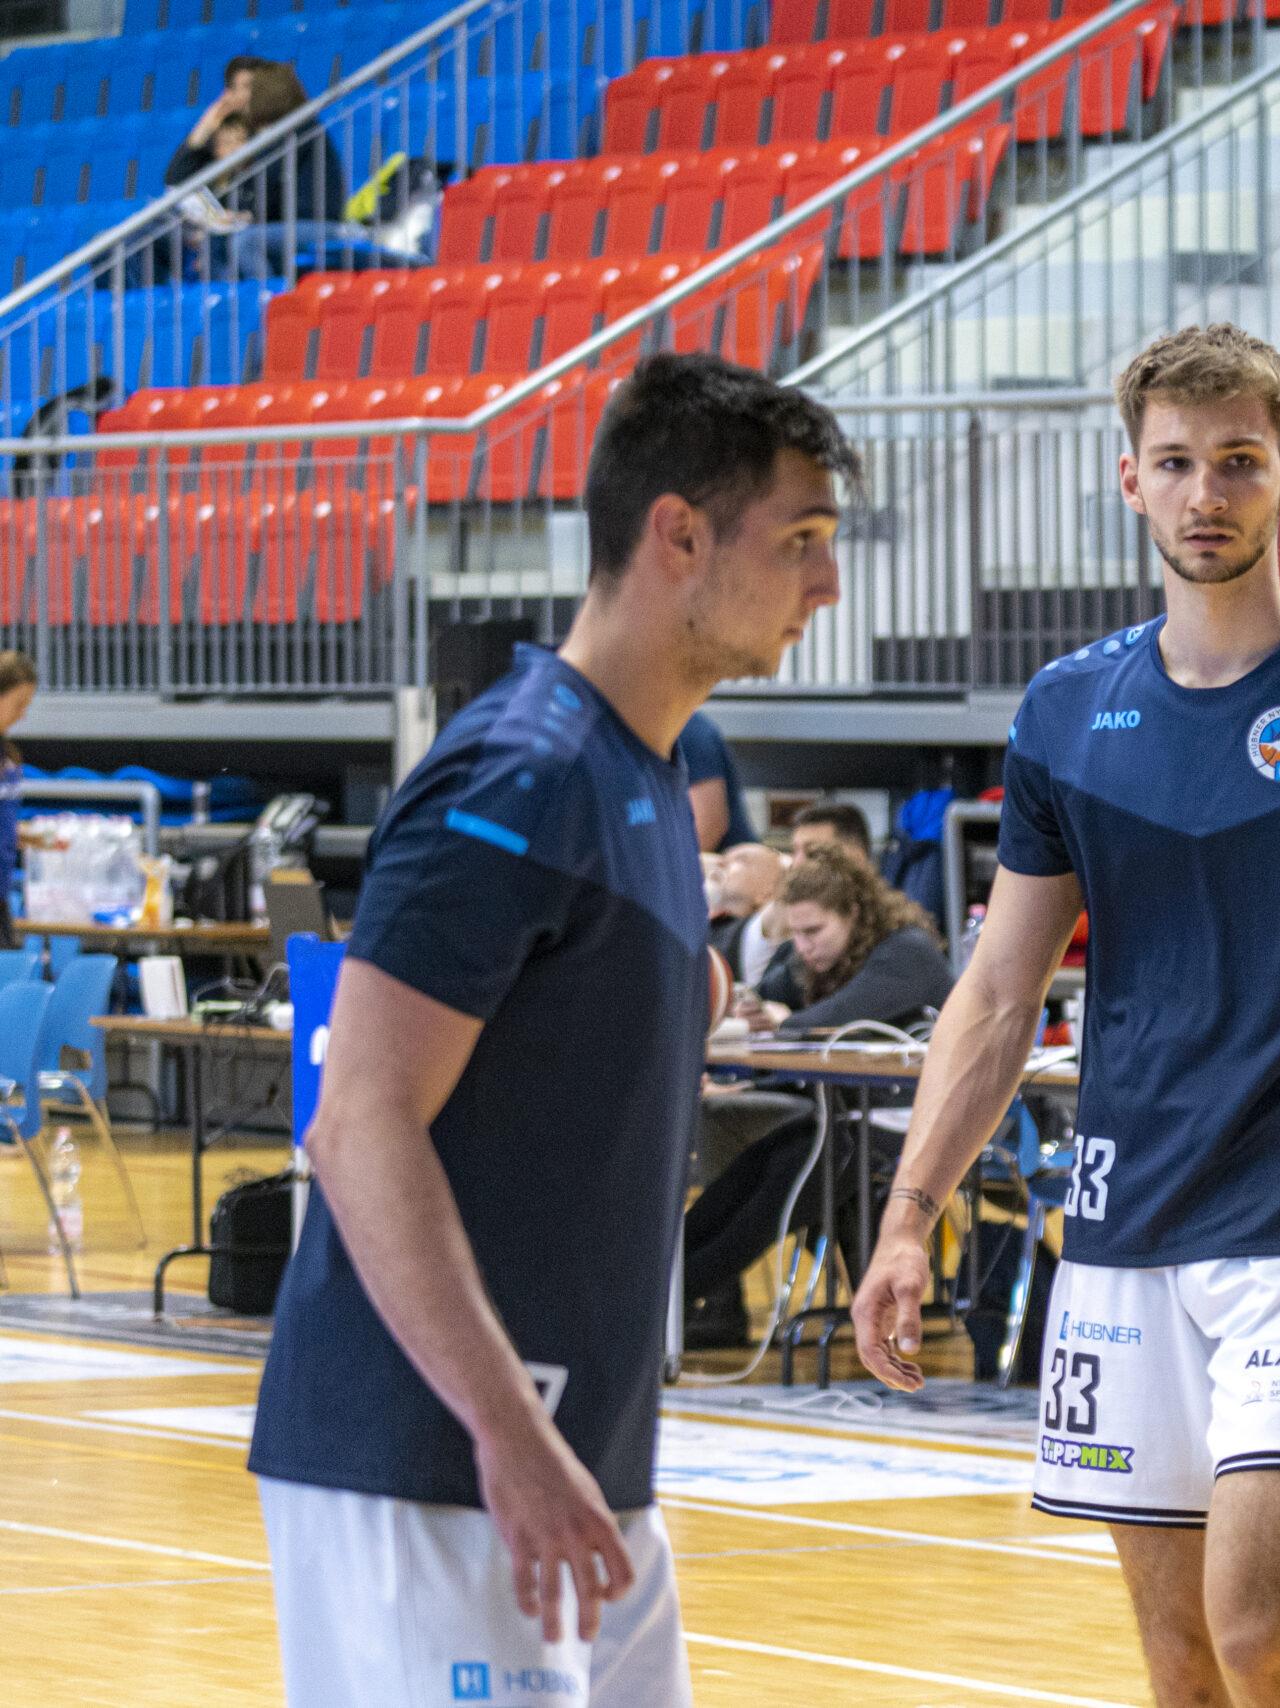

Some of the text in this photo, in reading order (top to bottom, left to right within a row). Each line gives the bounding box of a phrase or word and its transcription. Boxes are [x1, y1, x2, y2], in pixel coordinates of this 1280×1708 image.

[1092, 710, 1141, 730] JAKO
[1064, 1134, 1117, 1221] 33
[1071, 1319, 1143, 1345] HÜBNER
[1045, 1347, 1101, 1435] 33
